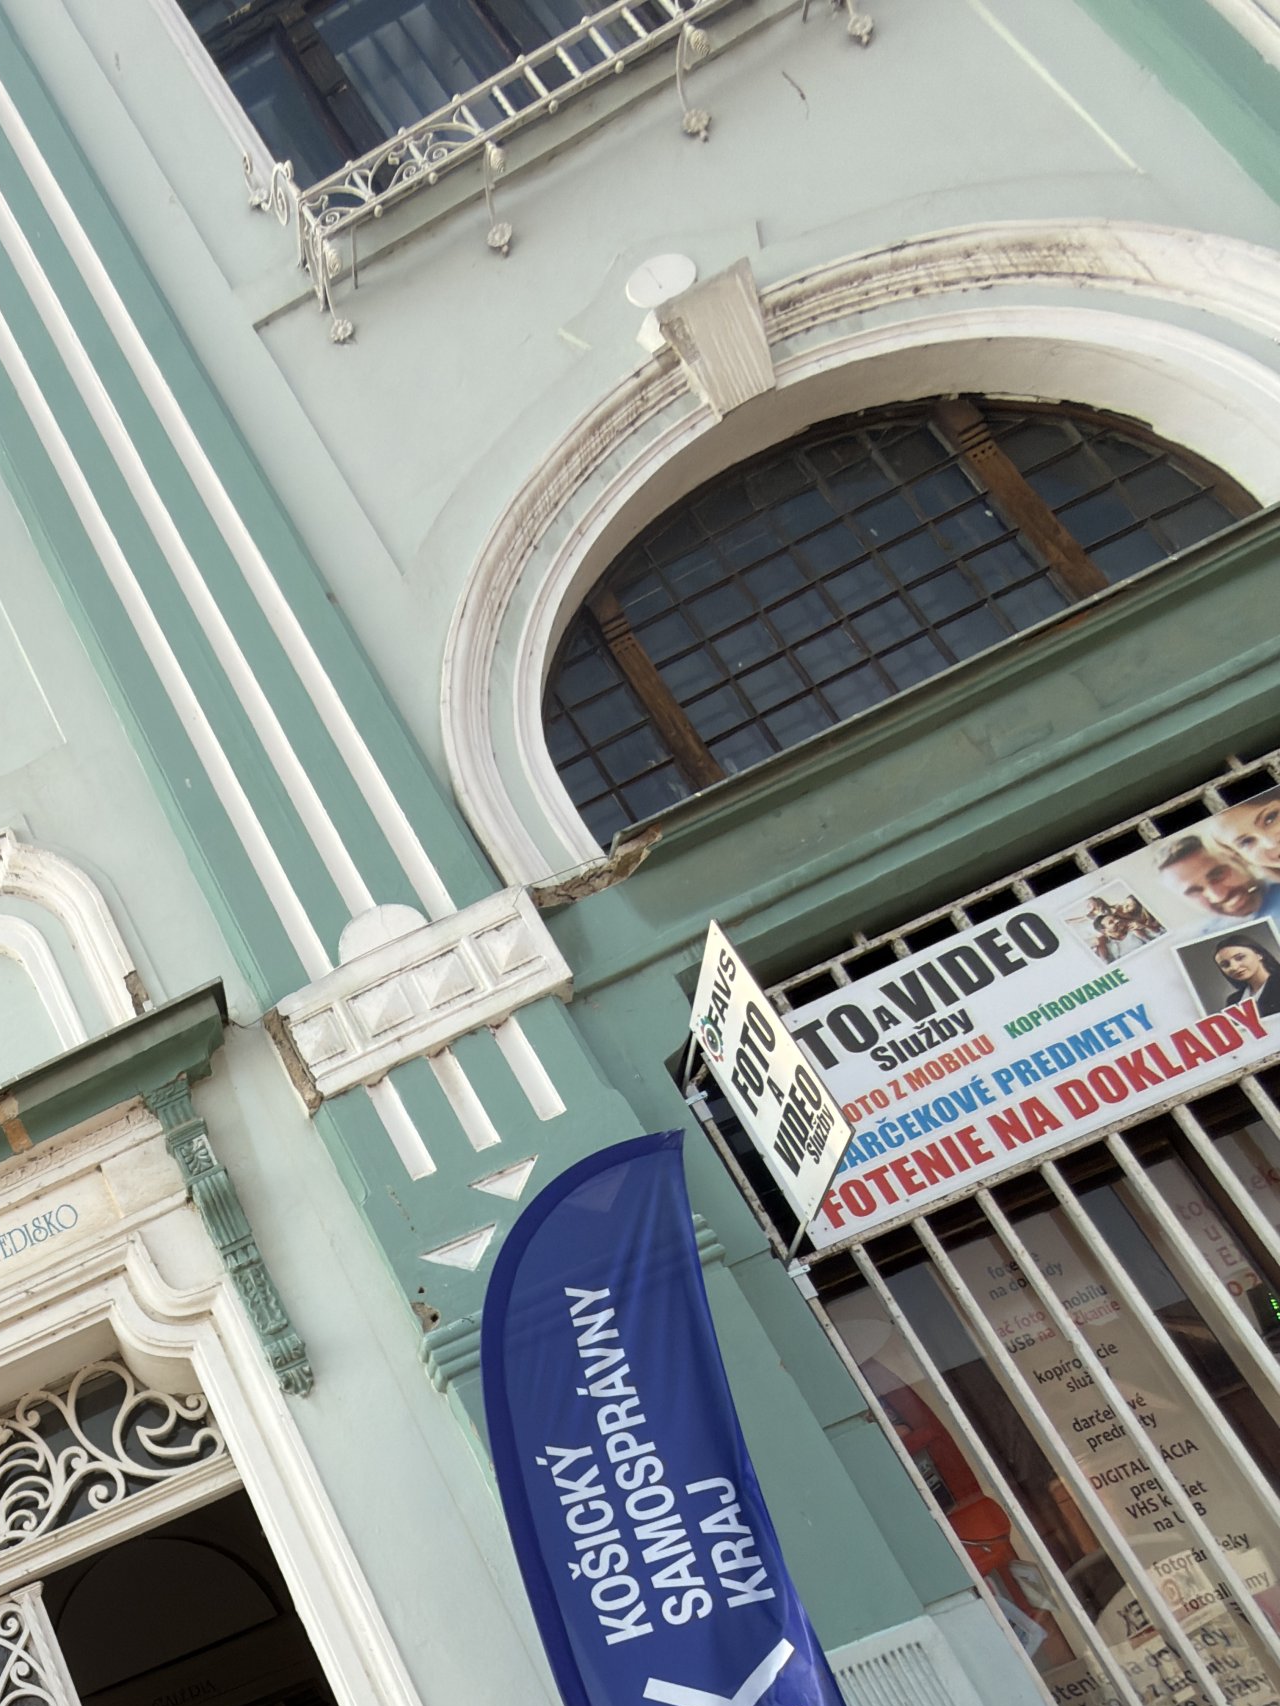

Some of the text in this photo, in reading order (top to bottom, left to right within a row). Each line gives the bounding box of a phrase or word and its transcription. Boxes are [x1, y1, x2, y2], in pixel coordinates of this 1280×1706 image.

[790, 912, 1060, 1070] TO A VIDEO
[1003, 968, 1130, 1040] KOPÍROVANIE
[731, 1000, 776, 1117] FOTO
[842, 1034, 995, 1123] OTO Z MOBILU
[869, 1008, 974, 1072] Služby
[991, 1003, 1154, 1096] PREDMETY
[767, 1075, 785, 1107] A
[773, 1064, 822, 1177] VIDEO
[821, 997, 1268, 1230] FOTENIE NA DOKLADY
[1033, 1342, 1119, 1385] kopírocie
[564, 1287, 713, 1625] SAMOSPRÁVNY
[1089, 1438, 1200, 1491] DIGITALÁCIA
[536, 1445, 654, 1645] KOŠICKÝ
[685, 1477, 776, 1608] KRAJ
[1125, 1498, 1160, 1520] VHS
[1153, 1516, 1175, 1533] na
